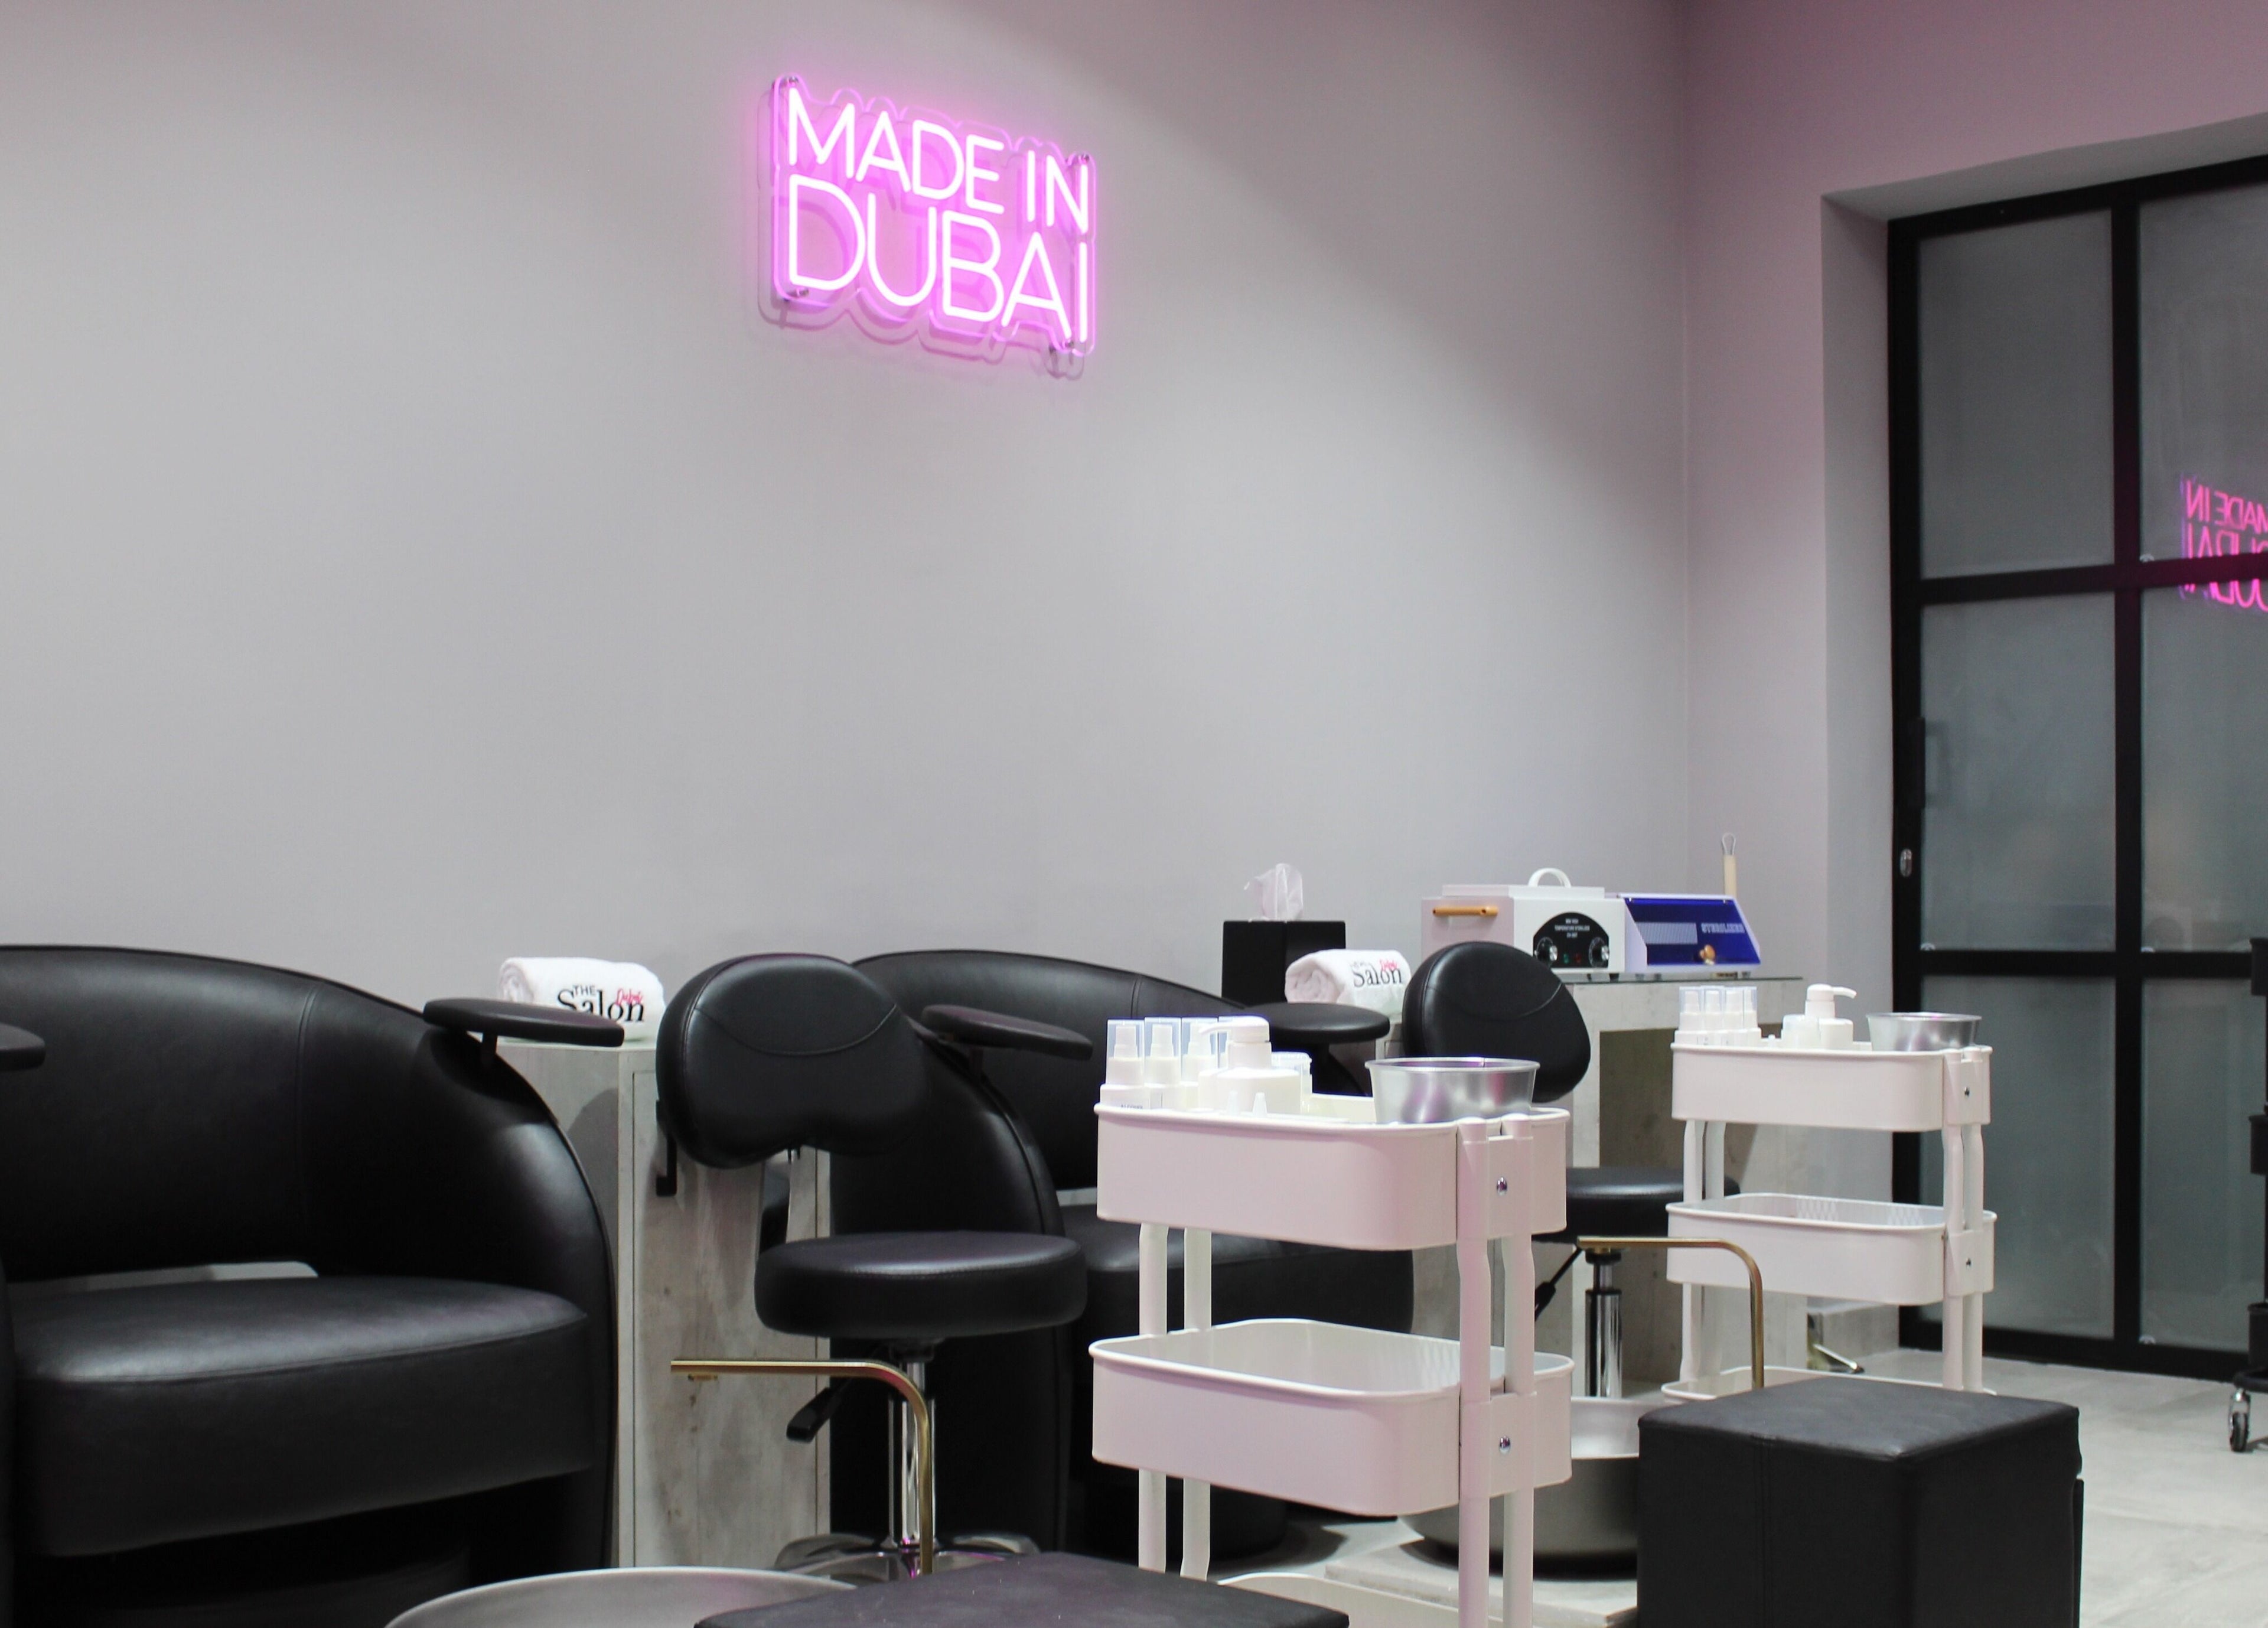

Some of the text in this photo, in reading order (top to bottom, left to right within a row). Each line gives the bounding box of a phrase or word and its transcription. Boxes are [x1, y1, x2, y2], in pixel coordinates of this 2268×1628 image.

[788, 86, 1089, 235] MADE IN
[788, 173, 1089, 343] DUBAI
[573, 985, 595, 995] THE
[1352, 962, 1403, 987] Salon
[558, 989, 644, 1022] Salon
